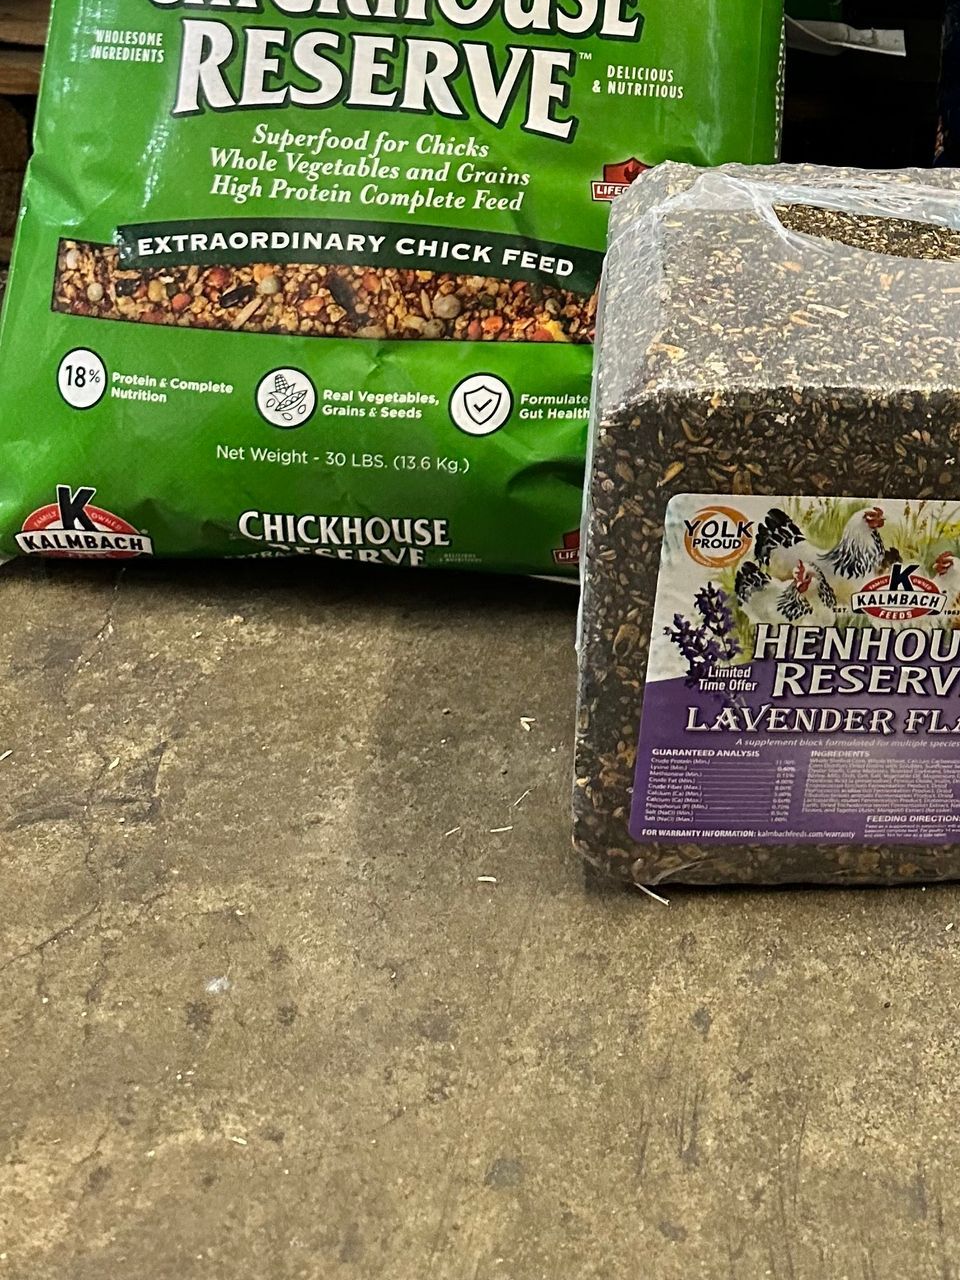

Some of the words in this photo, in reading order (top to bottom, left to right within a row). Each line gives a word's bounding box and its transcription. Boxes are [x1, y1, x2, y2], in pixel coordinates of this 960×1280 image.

[95, 28, 164, 48] WHOLESOME
[90, 44, 165, 64] INGREDIENTS
[171, 17, 580, 143] RESERVE
[606, 64, 675, 84] DELICIOUS
[606, 80, 685, 100] NUTRITIOUS
[251, 123, 369, 158] Superfood
[372, 131, 411, 159] for
[415, 133, 490, 158] Chicks
[209, 146, 278, 173] Whole
[285, 150, 400, 184] Vegetables
[405, 161, 447, 182] and
[450, 163, 531, 188] Grains
[210, 173, 264, 201] High
[268, 181, 352, 204] Protein
[358, 186, 466, 214] Complete
[472, 189, 524, 212] Feed
[137, 230, 386, 257] EXTRAORDINARY
[394, 238, 492, 265] CHICK
[502, 248, 575, 277] FEED
[65, 364, 101, 389] 18%
[111, 371, 158, 388] Protein
[170, 377, 235, 395] Complete
[110, 387, 168, 404] Nutrition
[322, 389, 355, 404] Real
[358, 390, 440, 407] Vegetables,
[321, 404, 366, 419] Grains
[380, 407, 423, 420] Seeds
[518, 407, 545, 420] Gut
[546, 407, 591, 420] Health
[216, 444, 247, 463] Net
[250, 447, 309, 467] Weight
[325, 452, 348, 466] 30
[351, 453, 389, 469] LBS.
[393, 454, 432, 472] (13.6
[435, 457, 470, 474] Kg.)
[238, 510, 451, 547] CHICKHOUSE
[684, 520, 755, 539] YOLK
[22, 534, 145, 552] KALMBACH
[692, 538, 742, 550] PROUD
[856, 592, 940, 609] KALMBACH
[878, 610, 913, 620] FEEDS
[707, 665, 752, 679] Limited
[699, 678, 728, 692] Time
[729, 678, 758, 693] Offer
[685, 705, 893, 736] LAVENDER
[651, 748, 716, 758] GUARANTEED
[716, 749, 760, 758] ANALYSIS
[745, 739, 798, 750] supplement
[825, 739, 876, 751] formulated
[891, 740, 928, 748] multiple
[929, 740, 960, 749] species
[810, 750, 871, 758] INGREDIENTS
[866, 815, 907, 823] FEEDING
[641, 828, 657, 836] FOR
[658, 829, 701, 837] WARRANTY
[702, 829, 756, 838] INFORMATION:
[757, 829, 856, 839] kalmbachfeeds.com/warranty
